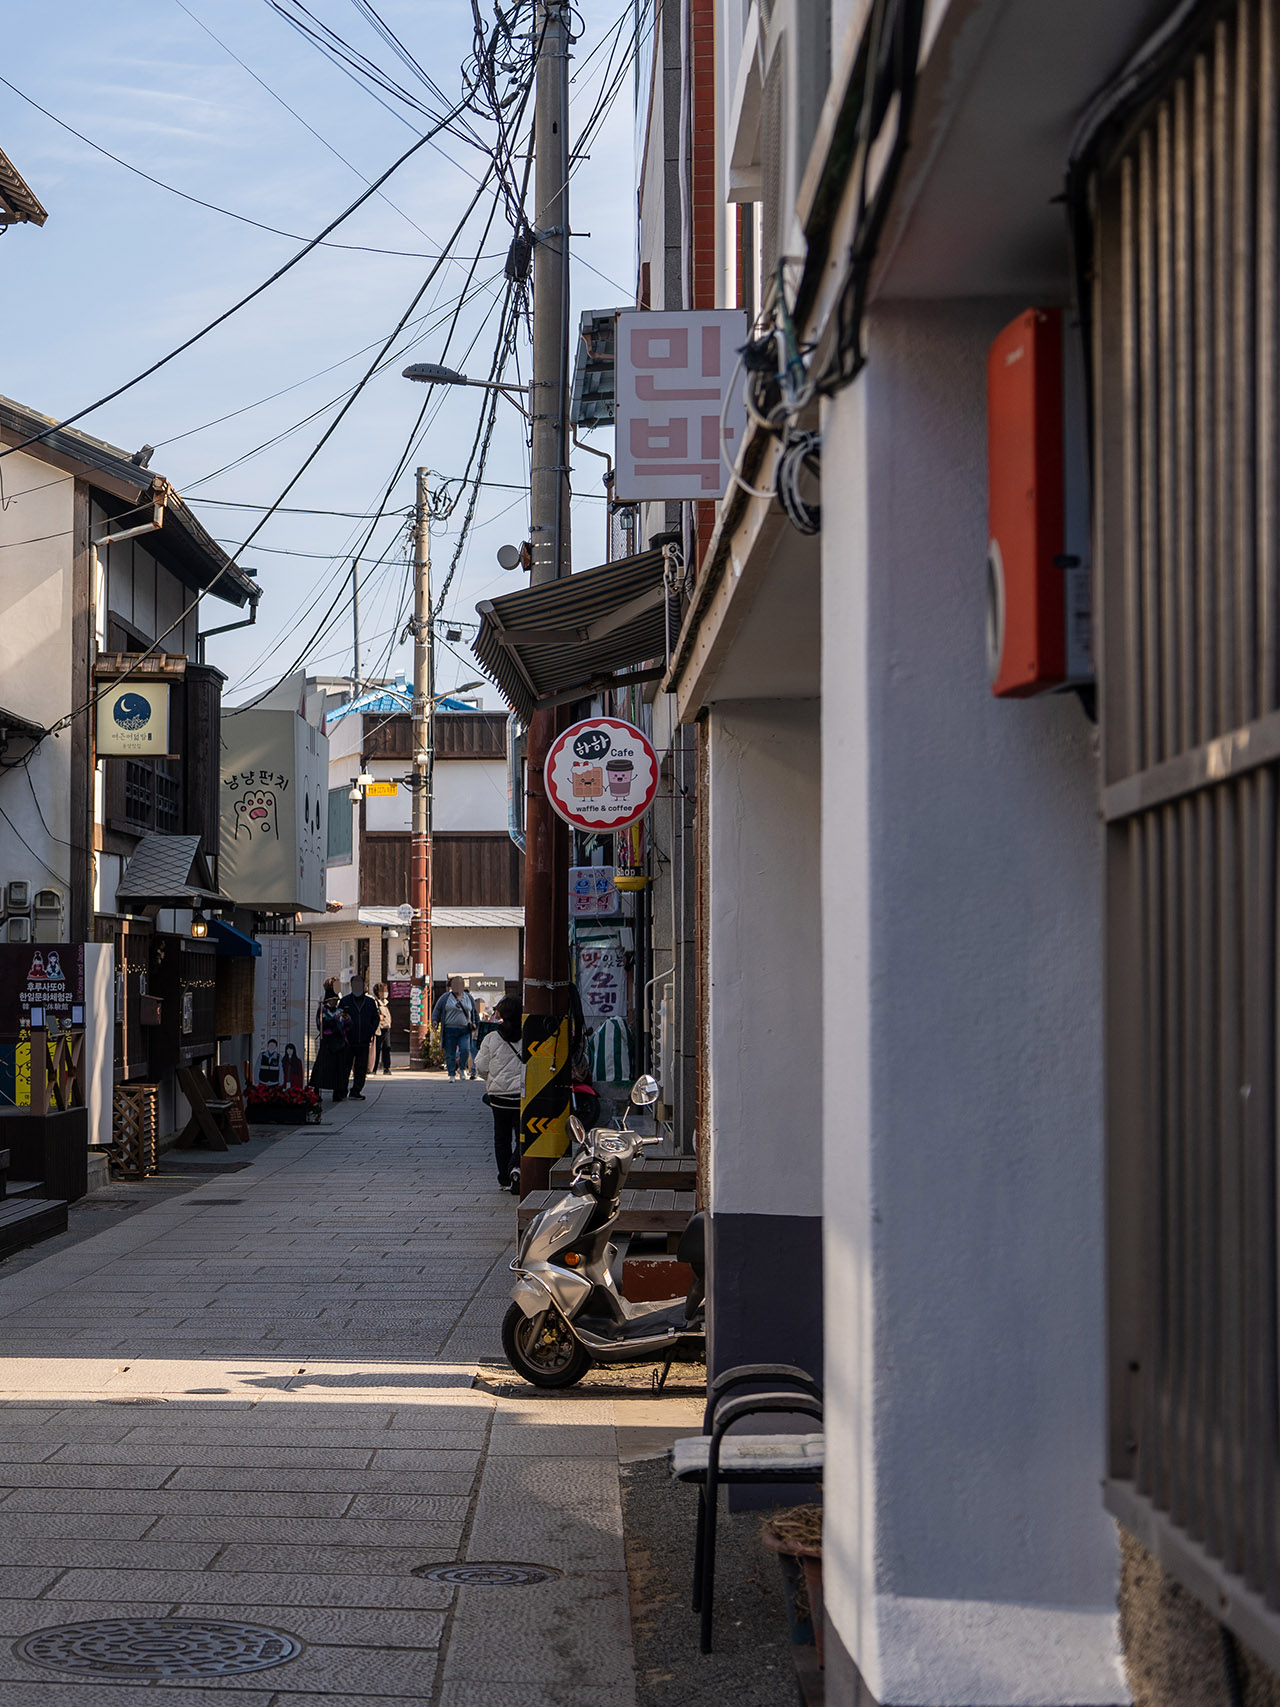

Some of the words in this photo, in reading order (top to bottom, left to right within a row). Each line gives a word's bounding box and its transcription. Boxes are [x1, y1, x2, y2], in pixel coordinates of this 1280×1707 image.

[630, 326, 734, 490] 민박
[576, 734, 609, 756] 하하
[611, 749, 634, 757] Cafe
[224, 770, 289, 792] 냥냥펀치
[577, 895, 609, 911] 분식
[19, 992, 73, 1002] 한일문화체험관
[27, 982, 66, 992] 후루사또야
[587, 972, 618, 1013] 오뎅
